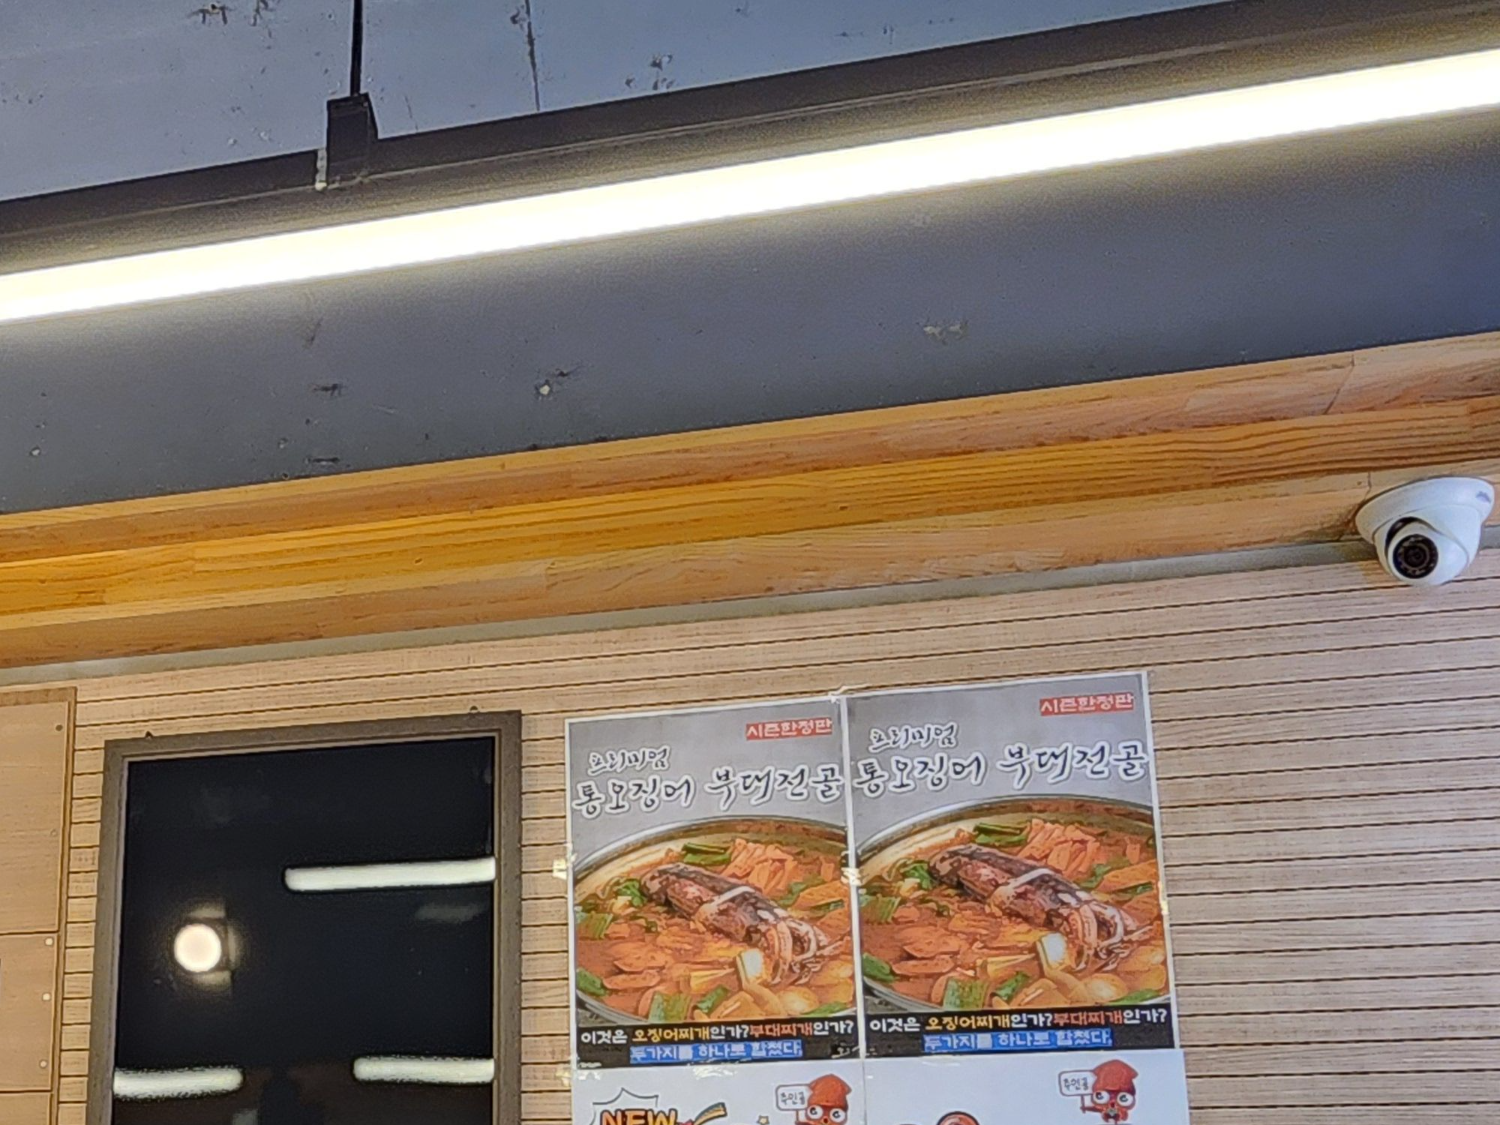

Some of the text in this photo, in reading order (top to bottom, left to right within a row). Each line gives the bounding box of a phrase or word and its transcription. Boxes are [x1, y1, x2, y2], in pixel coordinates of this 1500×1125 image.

[573, 764, 845, 818] 통오징어 부대전골
[853, 739, 1149, 796] 통오징어 부대전골
